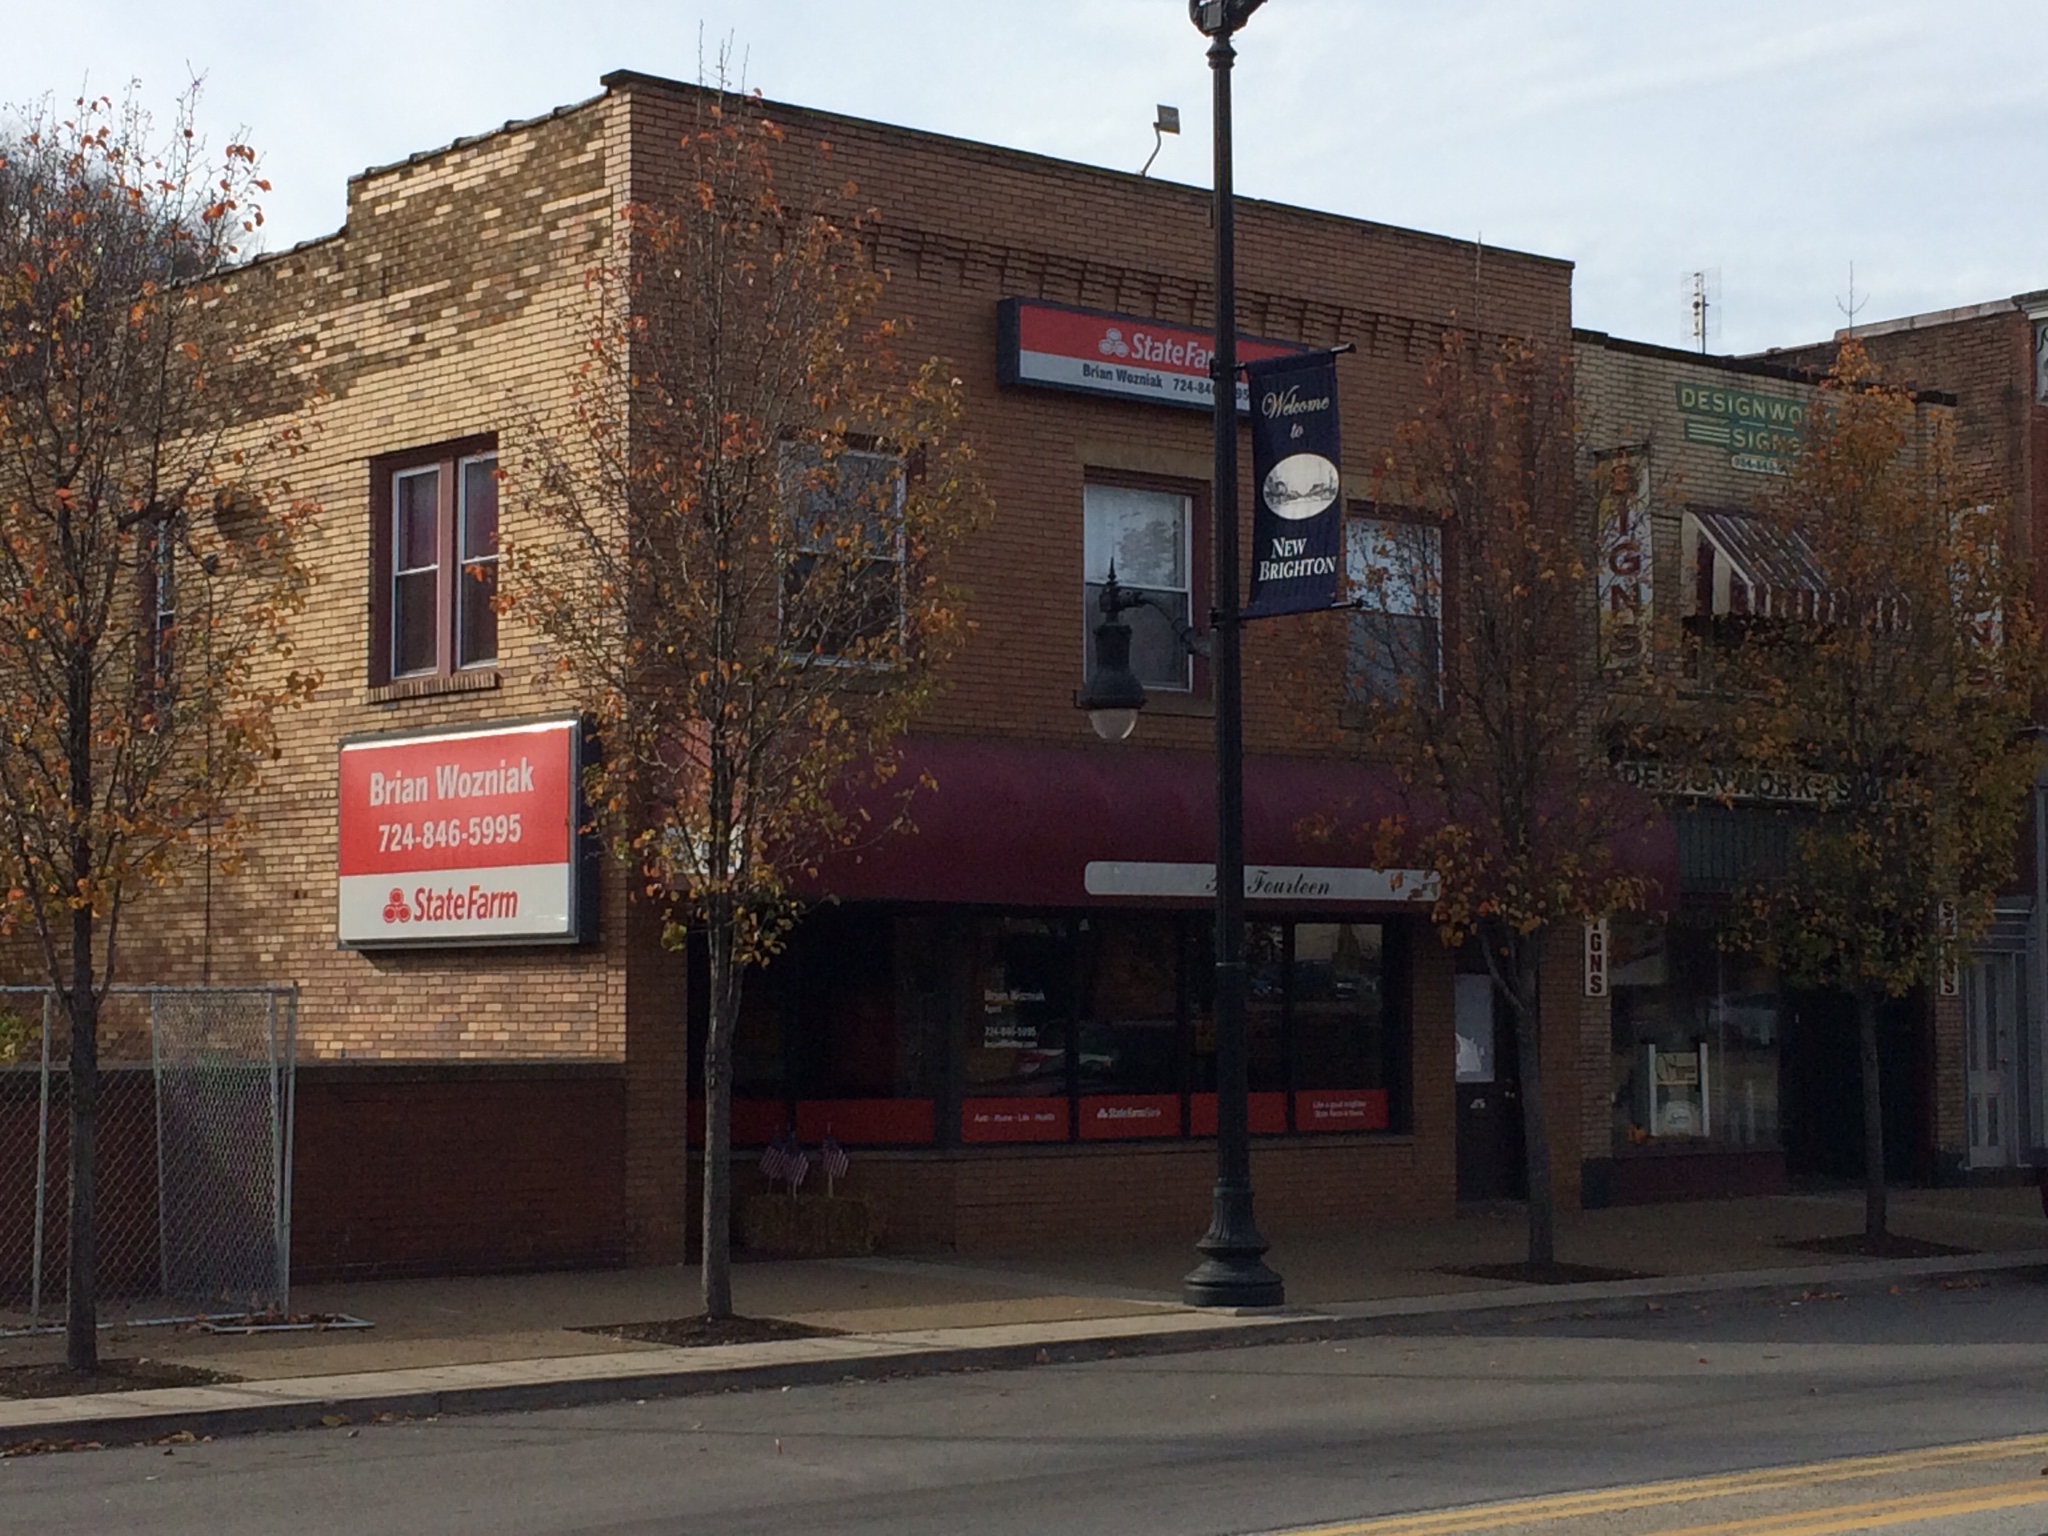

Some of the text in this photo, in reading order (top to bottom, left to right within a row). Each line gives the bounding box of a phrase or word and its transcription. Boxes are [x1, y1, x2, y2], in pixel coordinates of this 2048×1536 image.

[1131, 333, 1215, 369] StateFar
[1082, 364, 1250, 401] Brian Wozniak 724-8495
[1261, 385, 1330, 420] Welcome
[1681, 387, 1803, 426] DESIGNWO
[1290, 422, 1304, 439] to
[1271, 537, 1308, 560] NEW
[1258, 556, 1337, 582] BRIGHTON
[369, 757, 534, 807] Brian Wozniak
[378, 813, 522, 853] 724-846-5995
[1247, 869, 1330, 896] Fourteen
[414, 885, 518, 922] StateFarm
